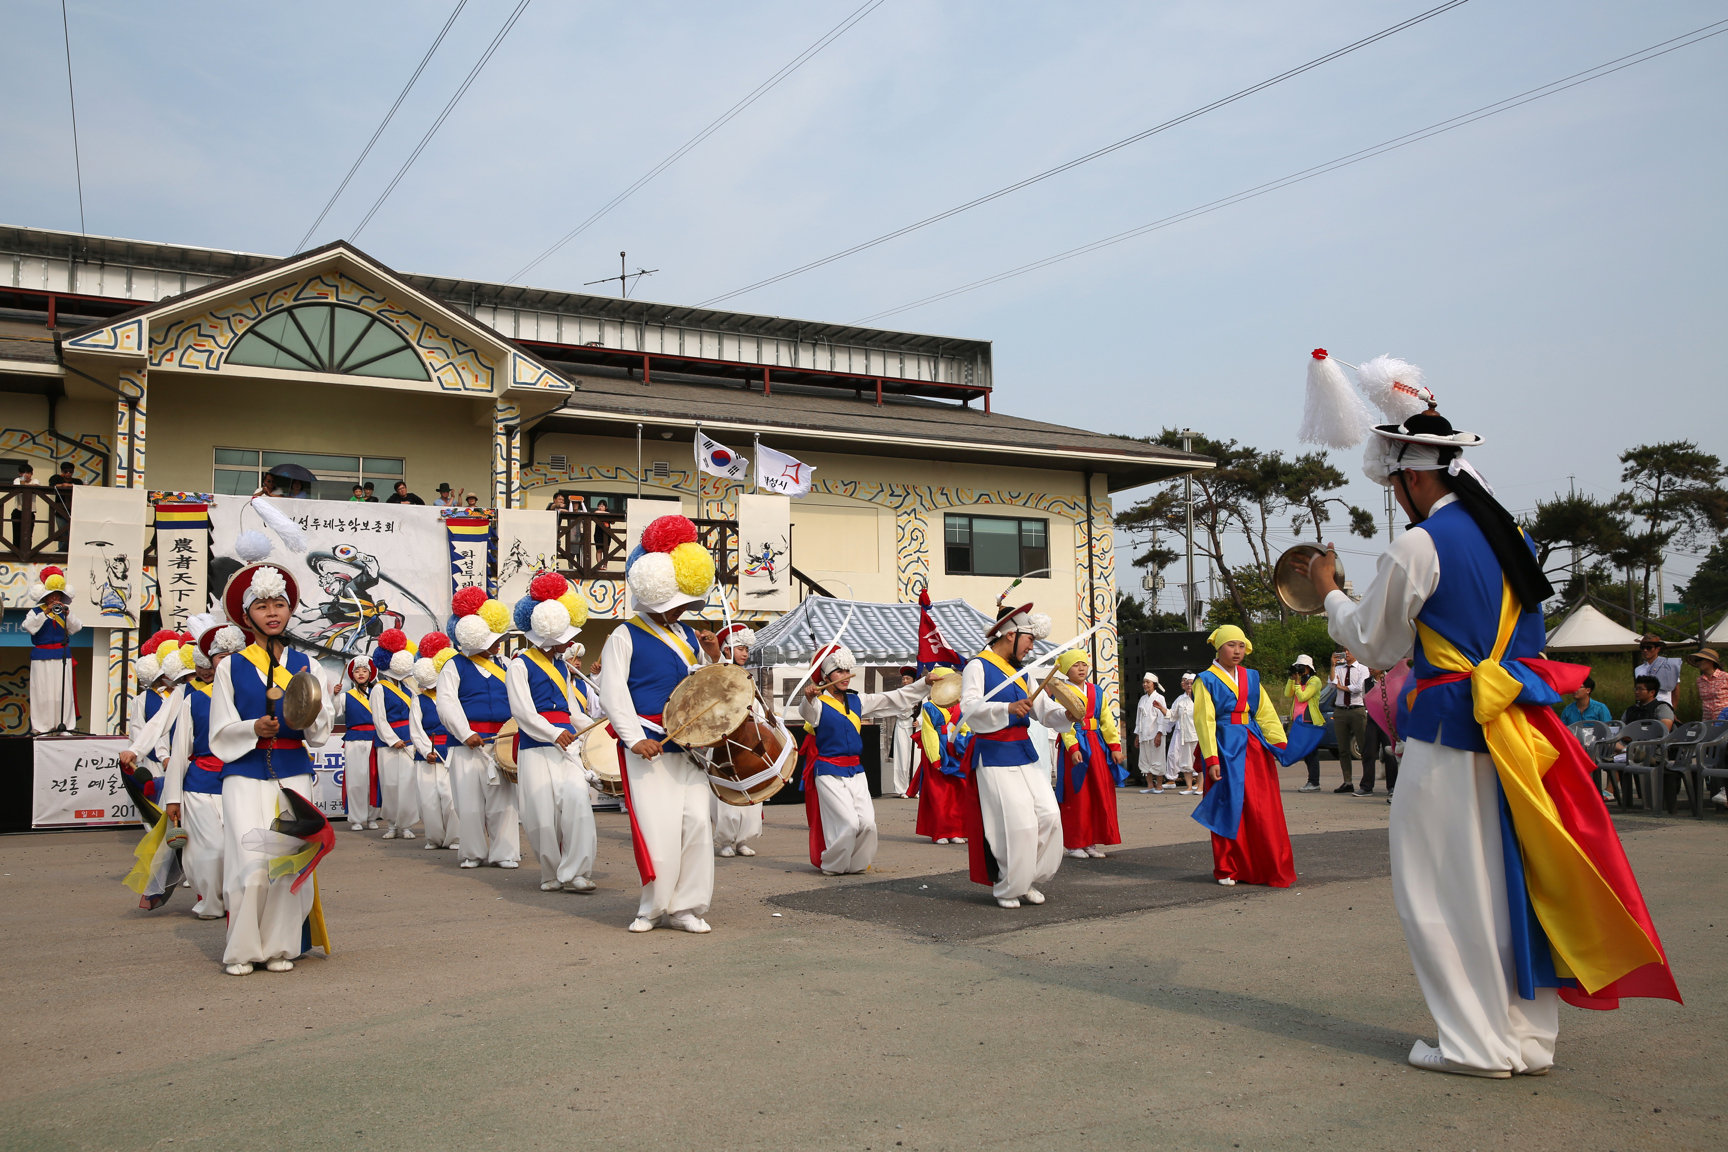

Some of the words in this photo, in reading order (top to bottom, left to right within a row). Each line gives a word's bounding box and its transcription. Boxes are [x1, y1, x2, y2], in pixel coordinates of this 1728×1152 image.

[50, 775, 79, 796] 전통
[87, 773, 126, 796] 예술
[111, 804, 136, 818] 201
